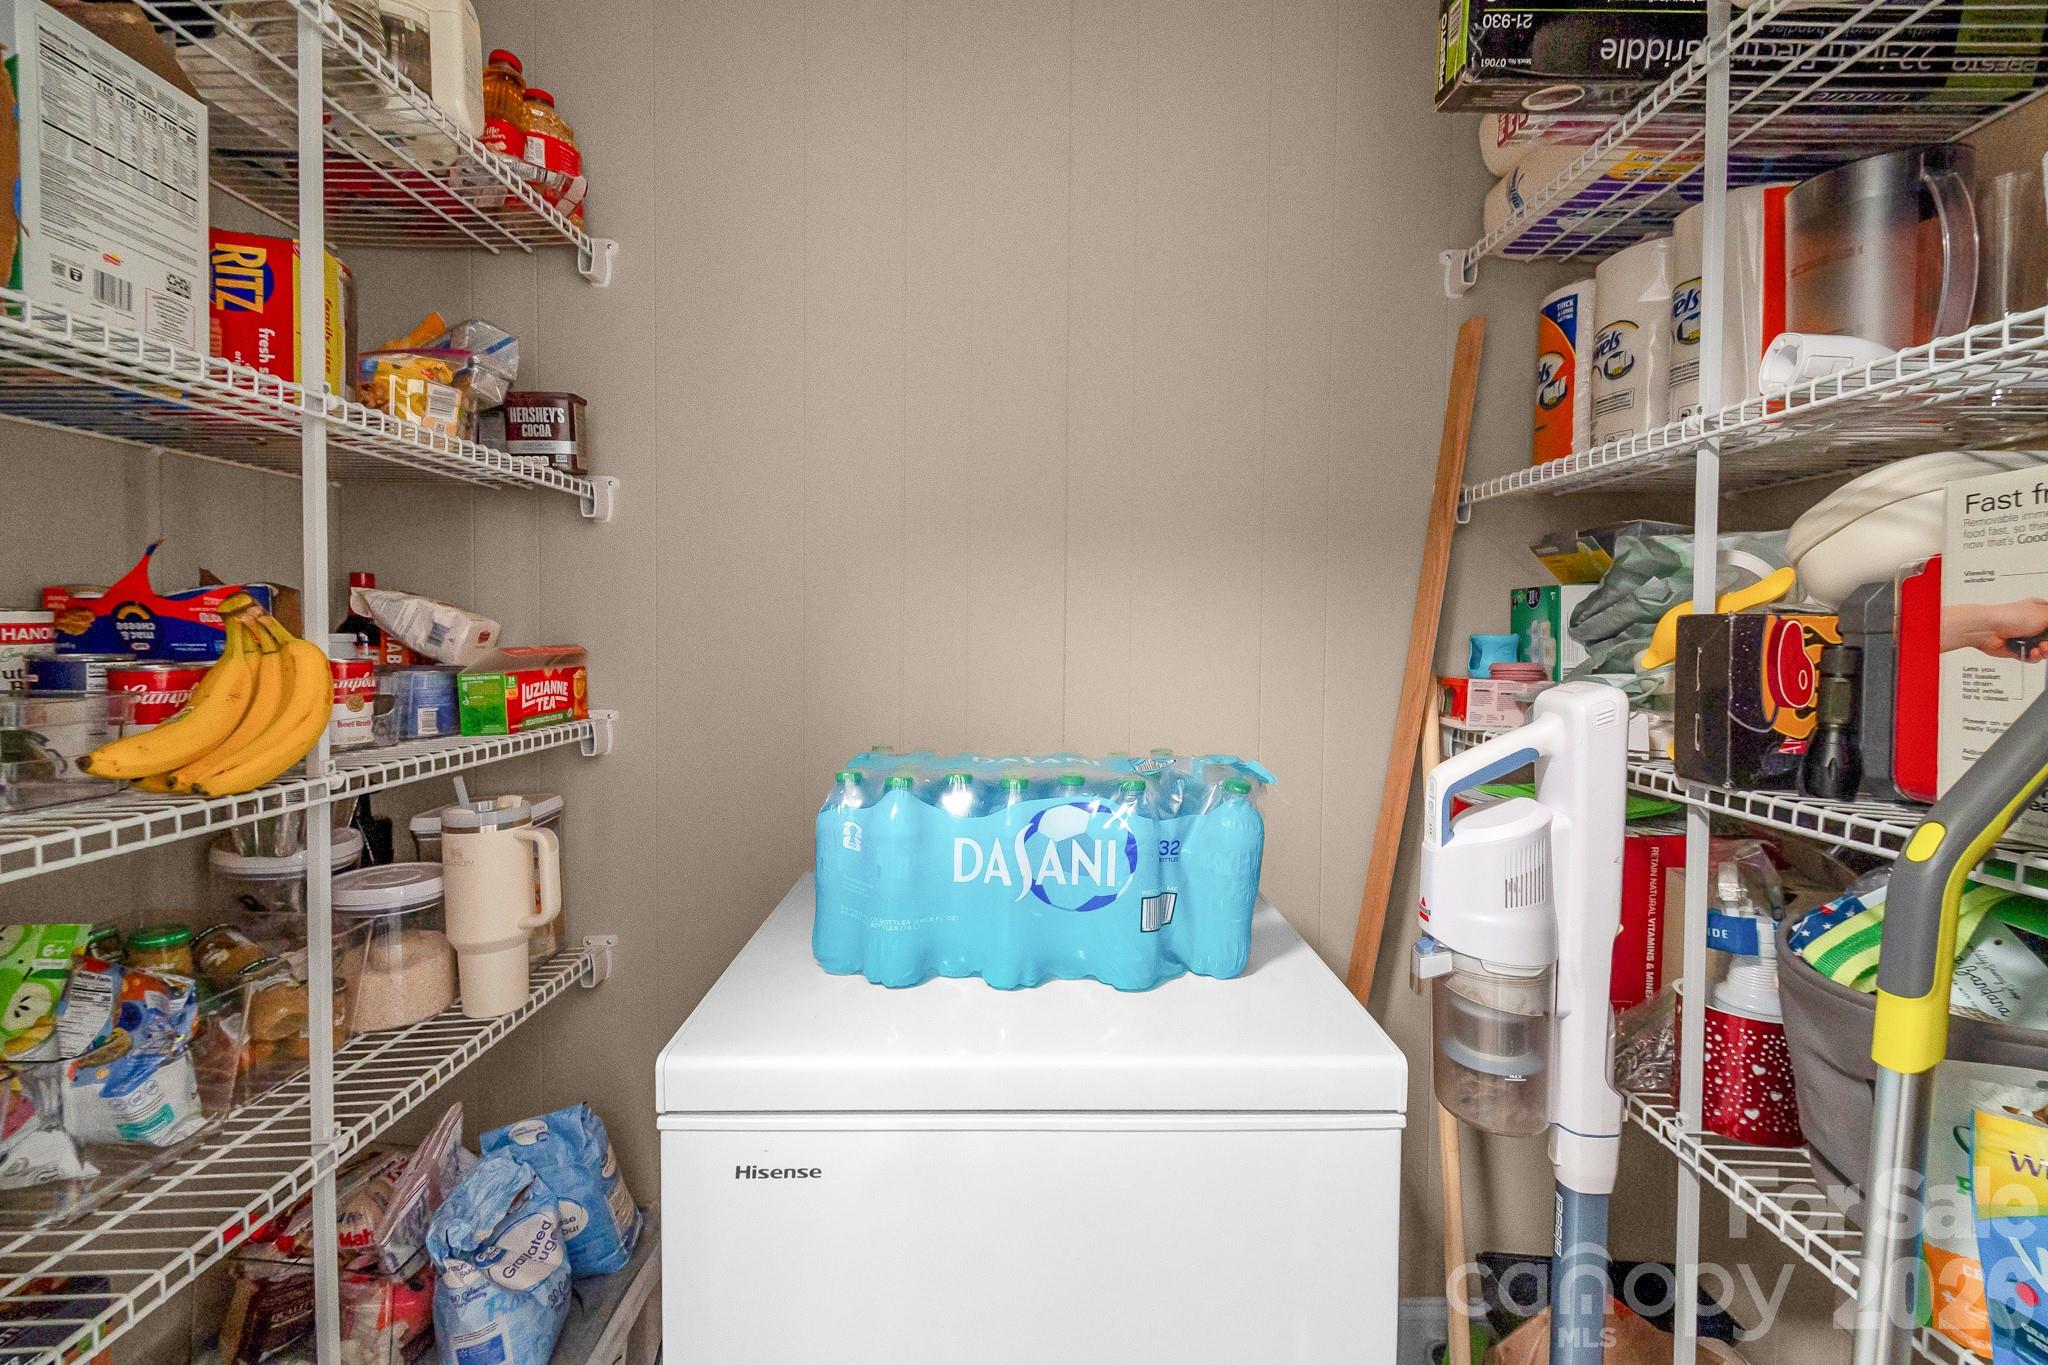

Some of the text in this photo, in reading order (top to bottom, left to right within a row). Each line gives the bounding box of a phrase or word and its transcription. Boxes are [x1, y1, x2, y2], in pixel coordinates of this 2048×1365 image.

[1482, 13, 1533, 29] 21-930
[1480, 58, 1507, 68] 07061
[210, 242, 267, 315] RITZ
[258, 327, 276, 364] fresh
[509, 406, 565, 423] HERSHEY'S
[521, 423, 552, 437] COCOA
[1965, 489, 2023, 515] Fast
[521, 679, 569, 709] LUZIANNE
[536, 695, 557, 712] TEA
[1159, 840, 1180, 855] 32
[952, 822, 1118, 903] DASANI
[1649, 846, 1660, 877] RETAIN
[1648, 878, 1657, 917] NATURAL
[1646, 917, 1656, 962] VITAMINS
[735, 1165, 822, 1179] Hisense
